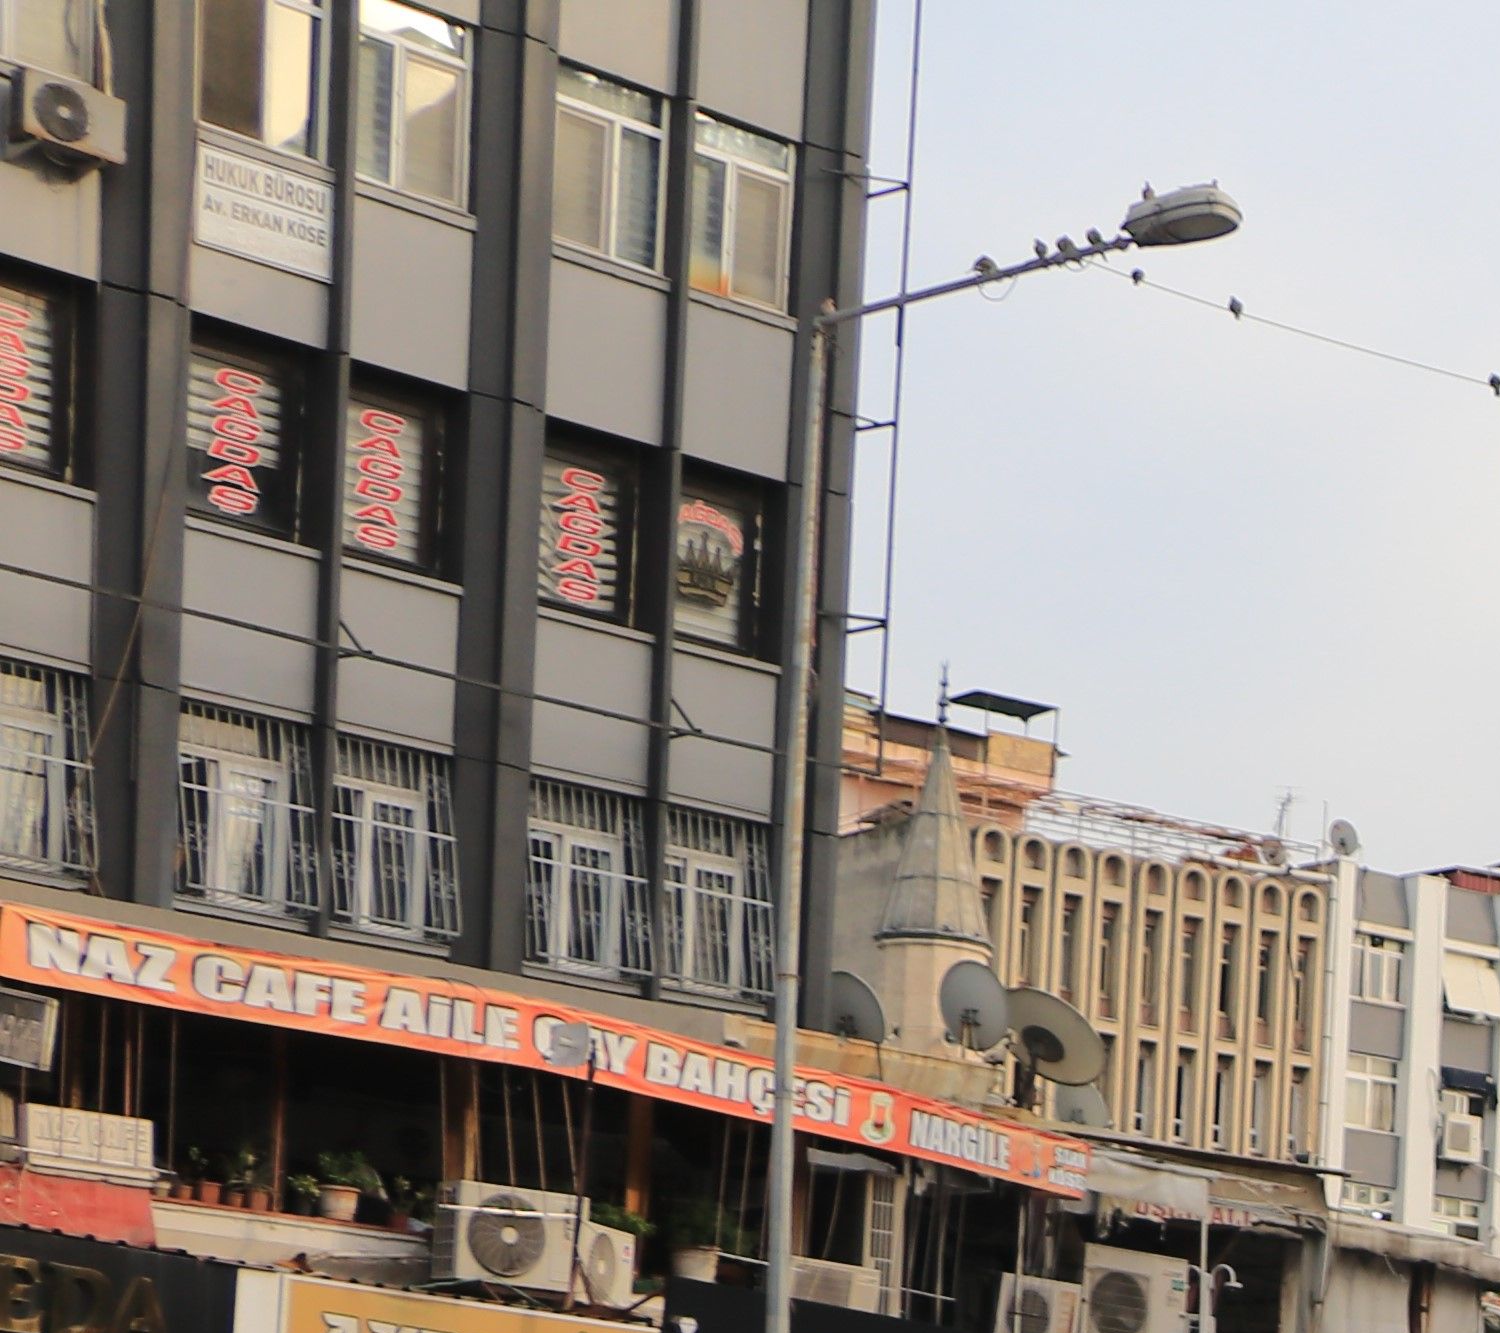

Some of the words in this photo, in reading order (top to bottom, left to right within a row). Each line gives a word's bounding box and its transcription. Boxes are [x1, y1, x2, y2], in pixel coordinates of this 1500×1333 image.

[204, 154, 262, 196] HUKUK
[264, 171, 327, 215] BÜROSU
[231, 202, 285, 235] ERKAN
[286, 219, 328, 248] KÖSE
[26, 919, 178, 993] NAZ
[191, 953, 368, 1025] CAFE
[379, 985, 521, 1050] AİLE
